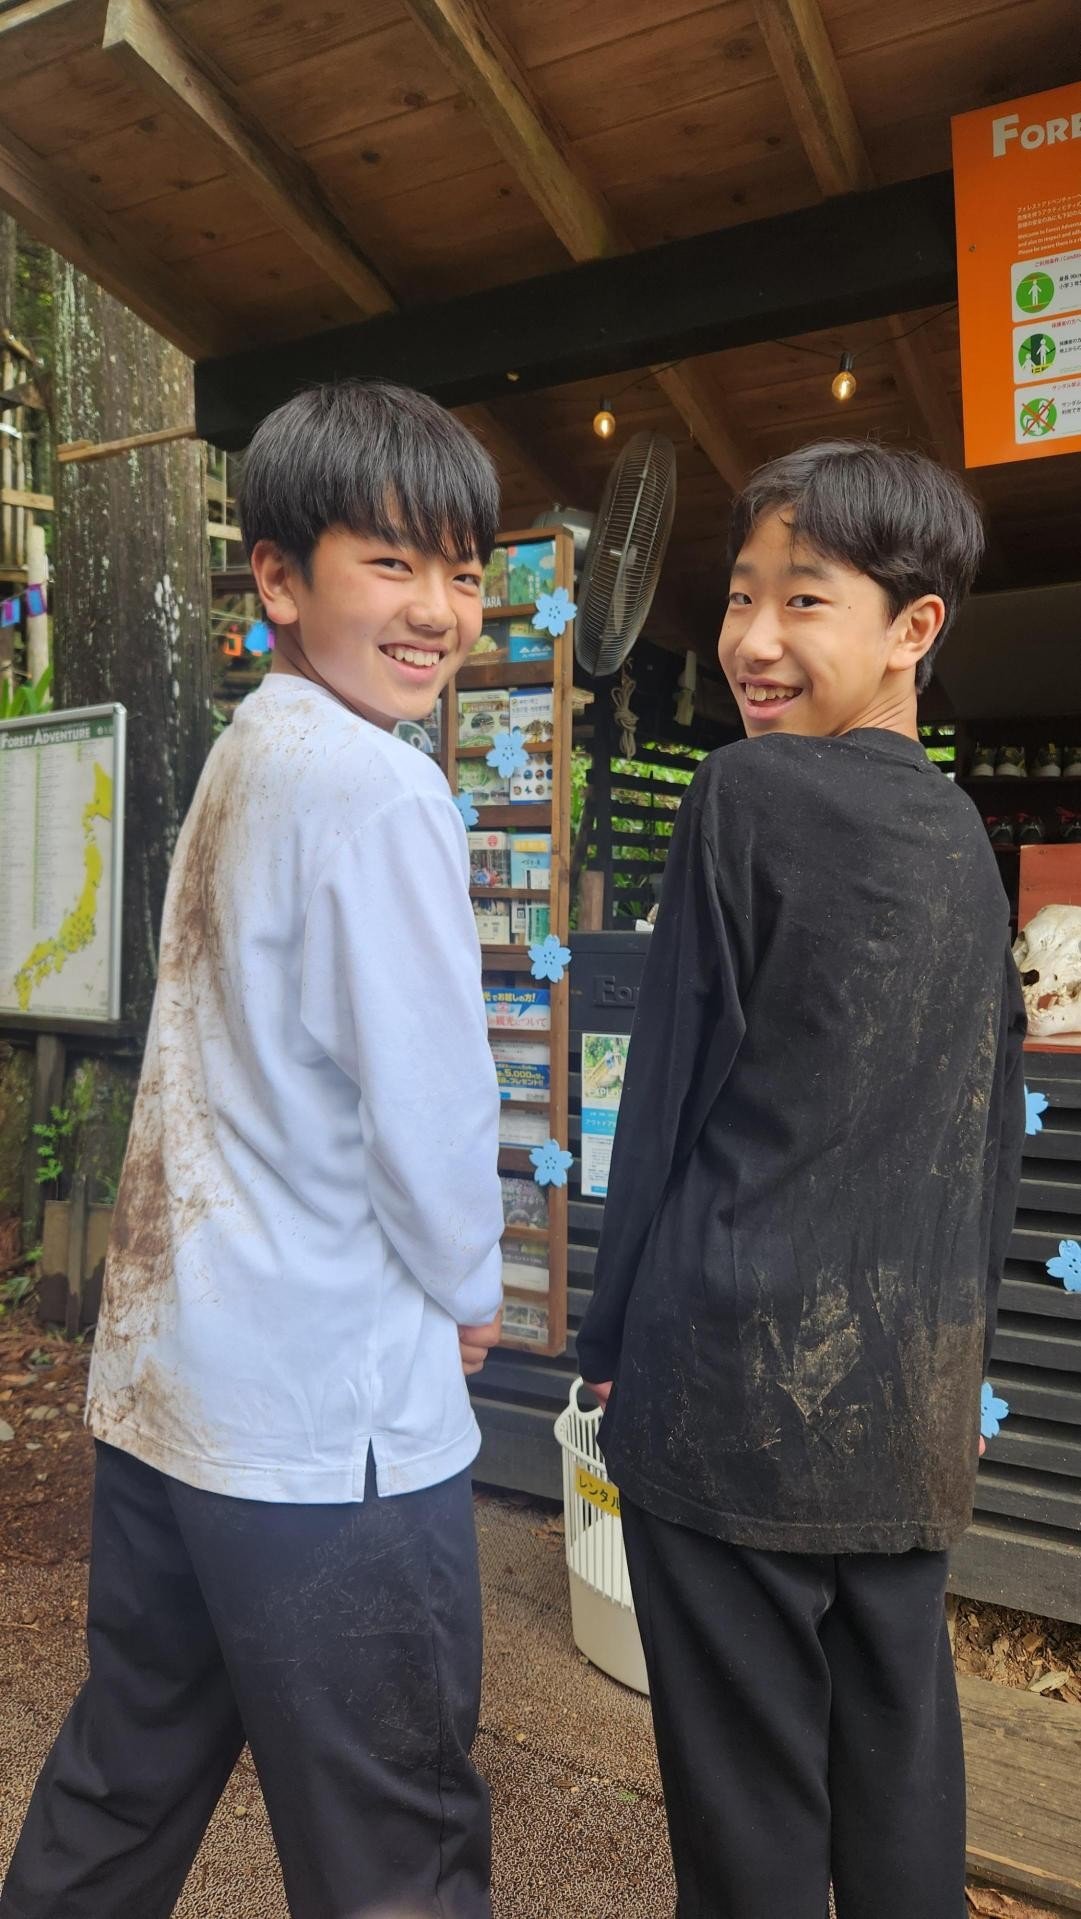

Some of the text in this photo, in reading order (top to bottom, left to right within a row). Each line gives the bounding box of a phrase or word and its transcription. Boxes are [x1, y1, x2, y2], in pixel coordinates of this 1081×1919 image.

[34, 726, 91, 745] ADVENTURE
[579, 1473, 621, 1510] レンタル
